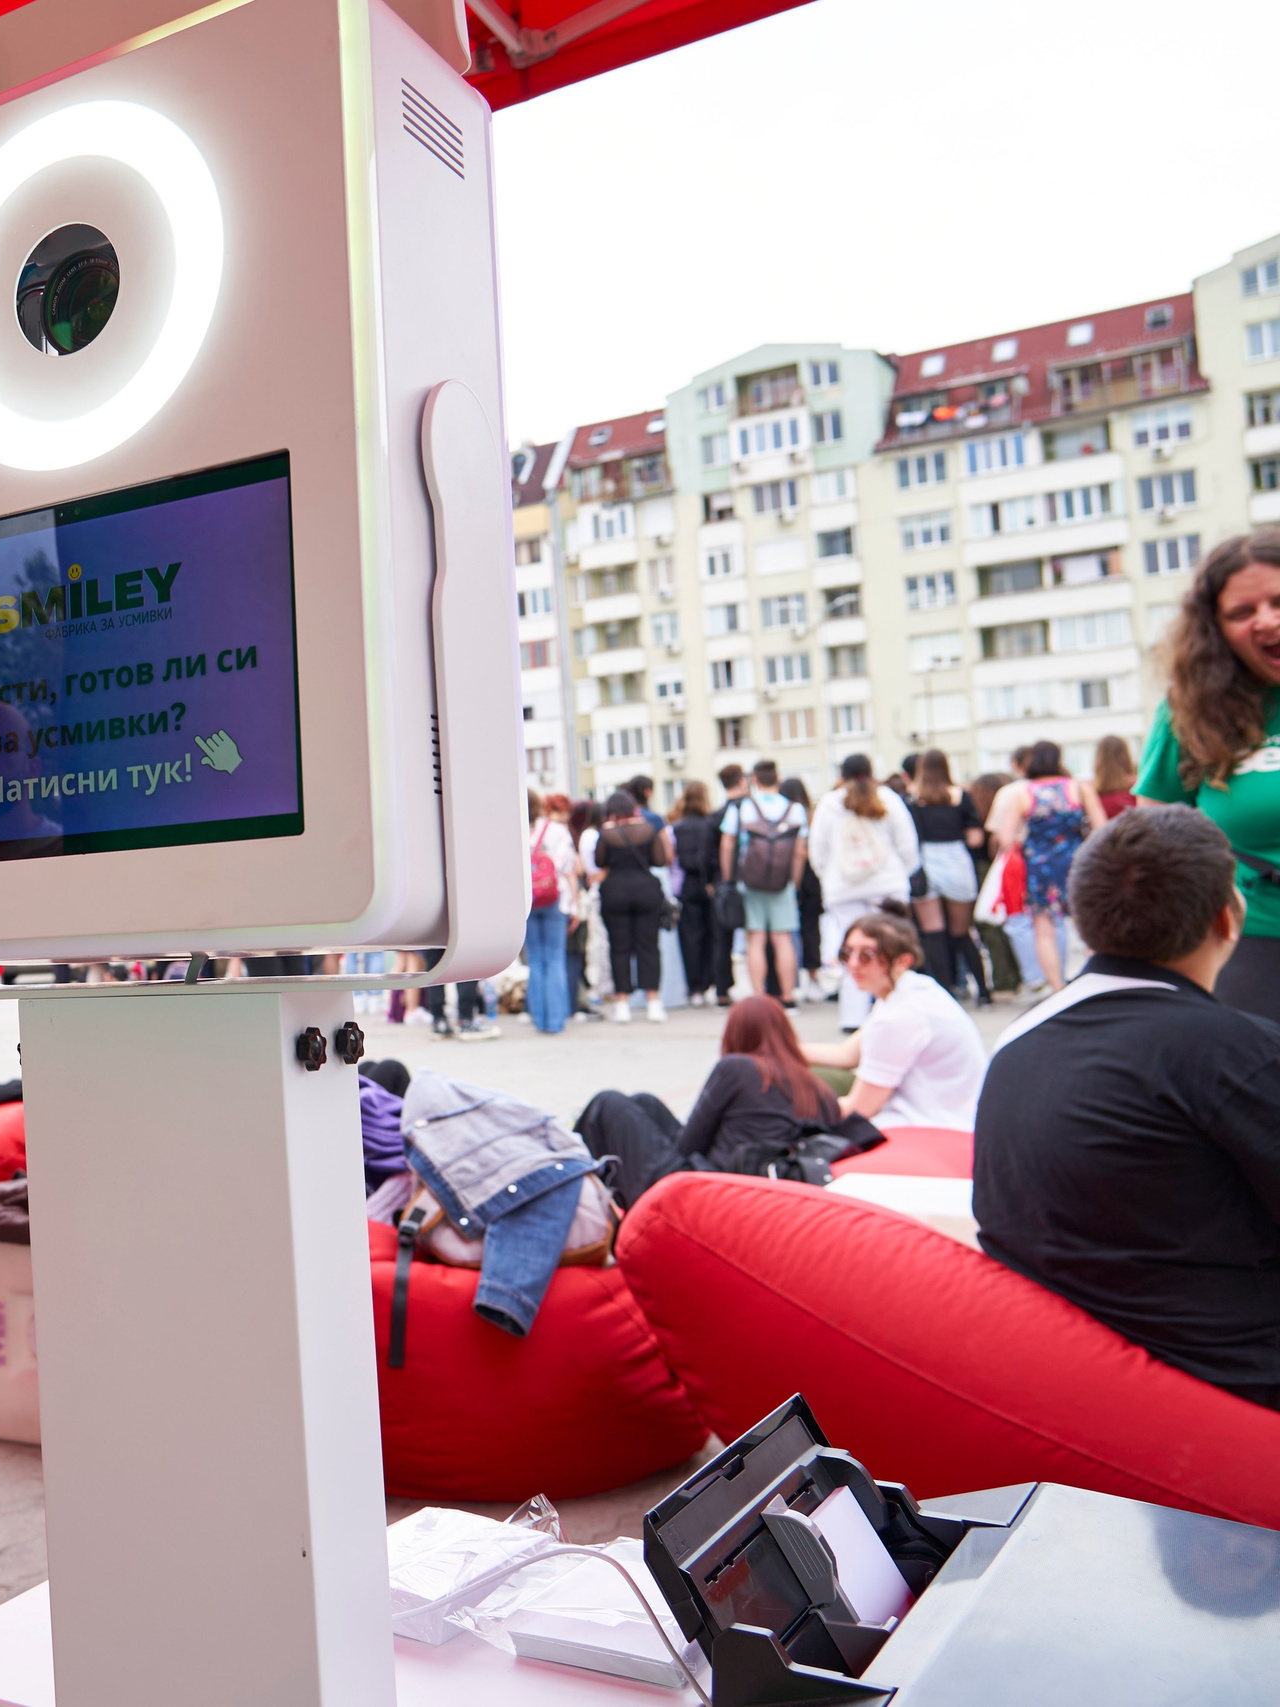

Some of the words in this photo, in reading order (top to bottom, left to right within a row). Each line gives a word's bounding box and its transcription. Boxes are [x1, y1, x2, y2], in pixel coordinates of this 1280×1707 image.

[45, 619, 97, 641] ФАБРИКА
[100, 617, 115, 632] ЗА
[119, 607, 173, 629] УСМИВКИ
[66, 662, 154, 696] готов
[162, 653, 206, 682] ли
[217, 645, 257, 674] си
[27, 703, 186, 759] усмивки?
[127, 753, 192, 796] тук!
